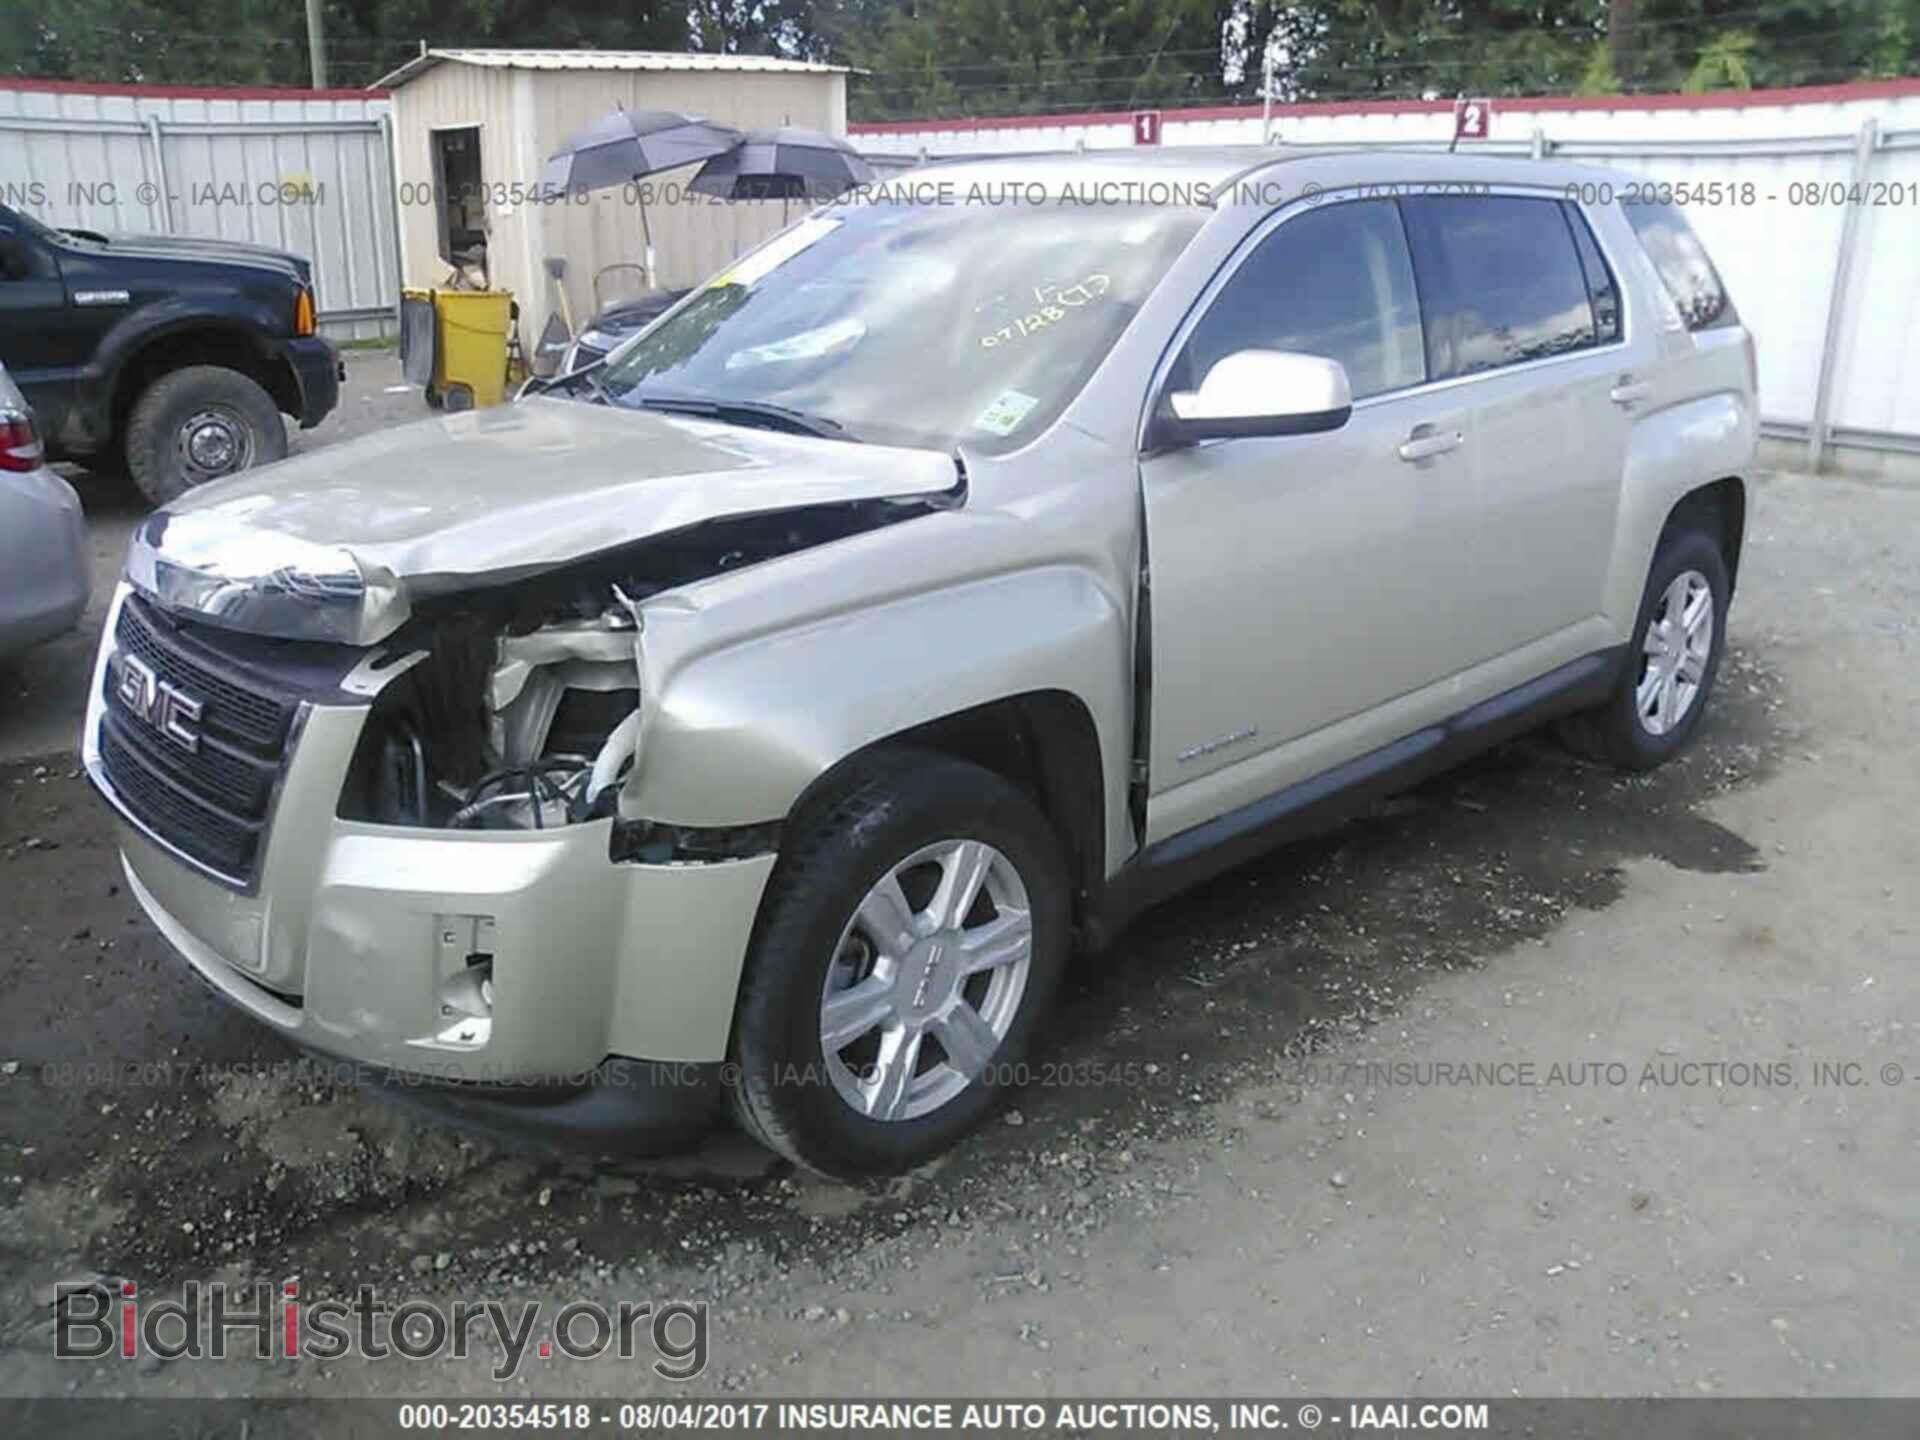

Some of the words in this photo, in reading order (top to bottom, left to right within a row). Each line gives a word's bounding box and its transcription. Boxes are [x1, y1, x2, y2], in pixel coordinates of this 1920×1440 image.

[1141, 116, 1151, 141] 1
[1463, 105, 1480, 133] 2
[116, 653, 203, 753] GMC
